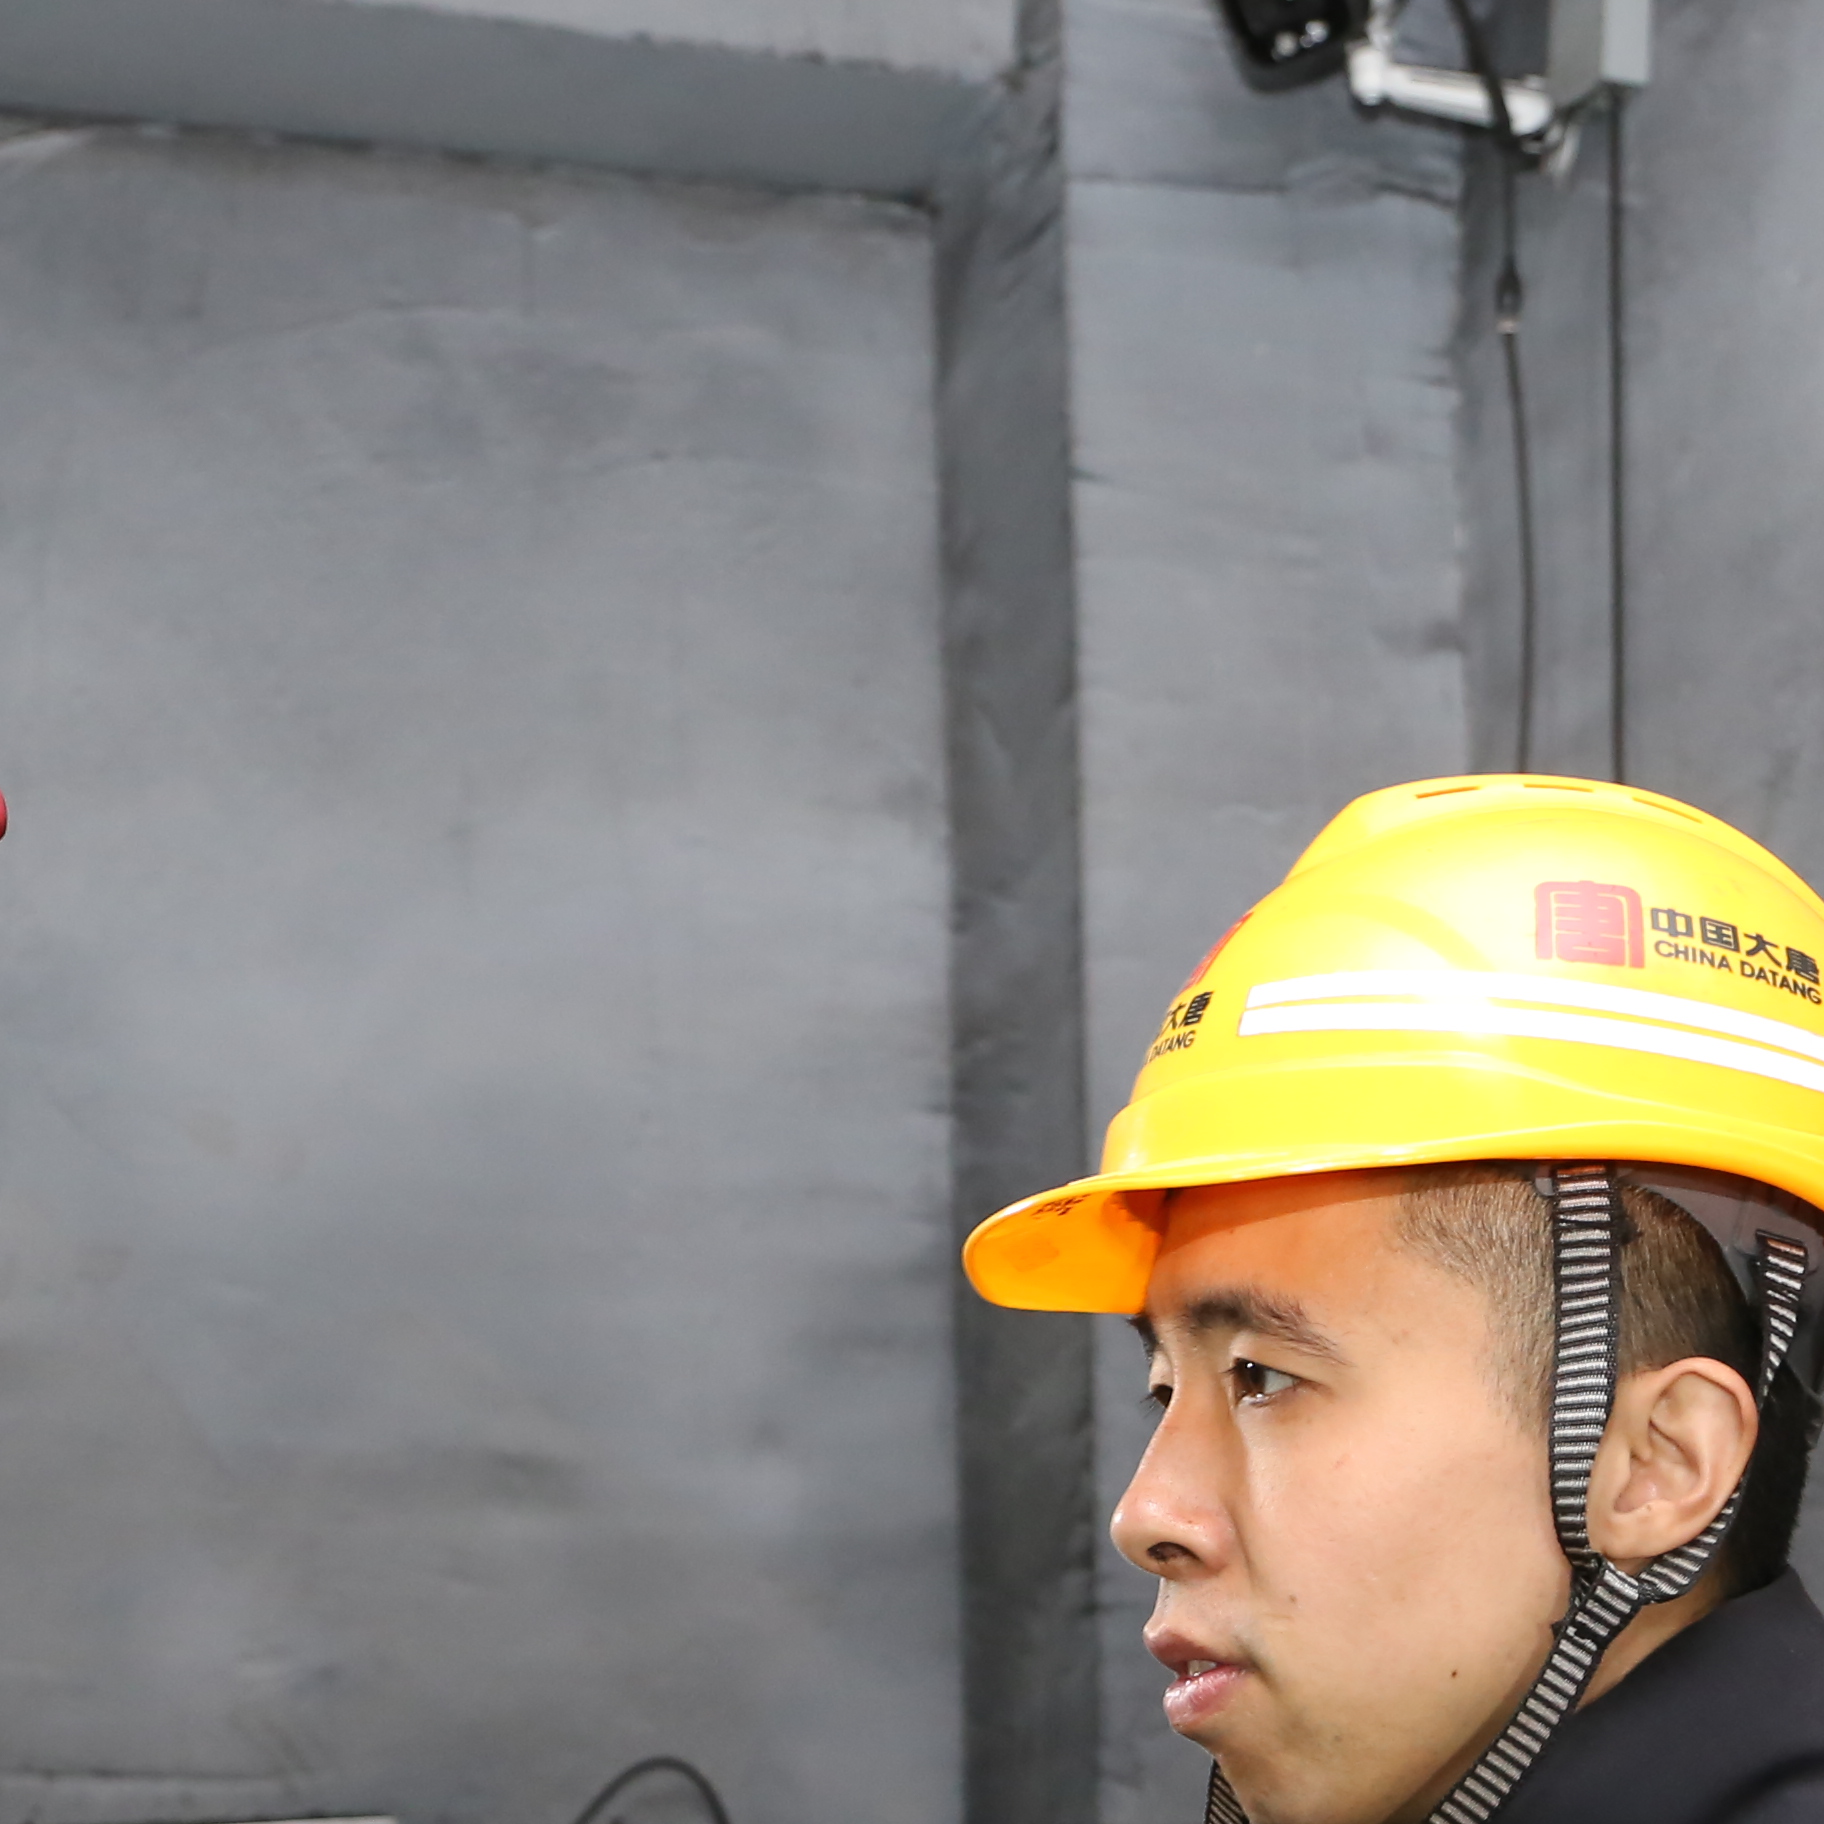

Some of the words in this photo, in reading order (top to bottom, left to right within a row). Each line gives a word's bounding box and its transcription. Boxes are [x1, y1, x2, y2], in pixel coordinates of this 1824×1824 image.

[1650, 907, 1821, 985] 中国大唐
[1653, 939, 1734, 974] CHINA
[1739, 960, 1823, 1006] DATANG
